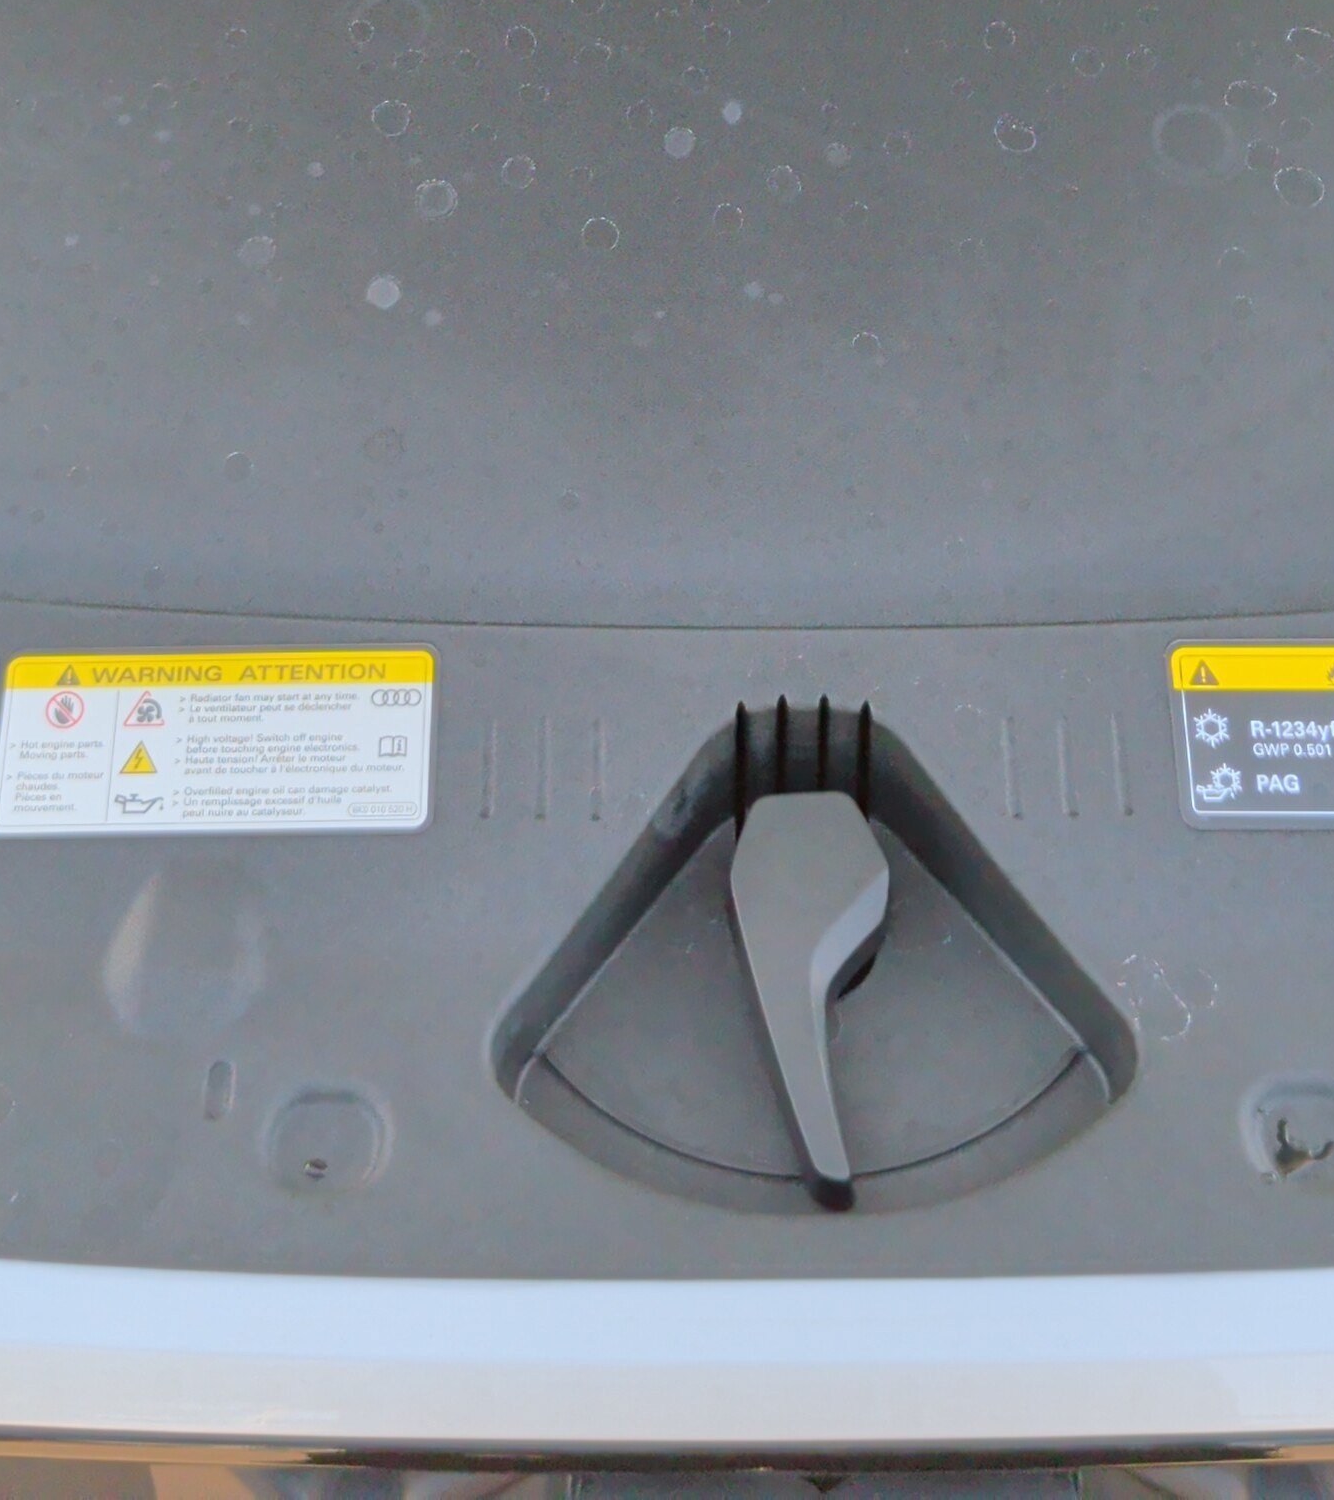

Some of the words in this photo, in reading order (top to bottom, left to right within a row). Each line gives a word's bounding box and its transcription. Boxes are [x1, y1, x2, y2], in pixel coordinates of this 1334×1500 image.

[93, 665, 222, 683] WARNING
[240, 663, 386, 681] ATTENTION
[190, 694, 232, 703] Radiator
[235, 694, 250, 702] fan
[253, 695, 274, 703] may
[278, 693, 299, 701] start
[314, 694, 332, 702] any
[335, 693, 359, 701] time.
[190, 704, 201, 712] Le
[203, 704, 256, 712] ventilateur
[260, 704, 281, 713] peut
[298, 701, 352, 711] déclencher
[189, 714, 194, 722] à
[197, 714, 217, 722] tout
[187, 735, 210, 745] High
[213, 734, 254, 744] voltage!
[257, 734, 290, 742] Switch
[293, 733, 306, 742] off
[309, 734, 343, 743] engine
[20, 741, 38, 749] Hot
[42, 742, 75, 751] engine
[78, 741, 104, 749] parts.
[186, 745, 218, 753] before
[221, 744, 265, 754] touching
[268, 745, 301, 754] engine
[304, 743, 359, 752] electronics.
[1252, 744, 1289, 757] GWP
[1293, 743, 1331, 757] 0.501
[20, 752, 57, 760] Moving
[60, 752, 87, 760] parts.
[186, 755, 214, 764] Haute
[217, 754, 258, 764] tension!
[261, 753, 295, 763] Arrêter
[298, 754, 307, 762] le
[184, 766, 212, 774] avant
[215, 766, 227, 774] de
[230, 765, 268, 774] toucher
[271, 764, 277, 773] à
[280, 764, 348, 774] l'électronique
[351, 764, 364, 772] du
[366, 764, 405, 772] moteur.
[17, 771, 48, 780] Pièces
[15, 783, 58, 791] chaudes.
[1256, 774, 1299, 793] PAG
[184, 786, 233, 795] Overfilled
[236, 787, 269, 797] engine
[272, 786, 284, 795] oil
[288, 787, 305, 795] can
[308, 785, 348, 795] damage
[352, 785, 392, 795] catalyst.
[15, 793, 47, 801] Pièces
[184, 797, 198, 805] Un
[201, 797, 262, 808] remplissage
[265, 796, 306, 805] excessif
[308, 795, 342, 805] d'huile
[13, 803, 76, 812] mouvement.
[182, 808, 204, 818] peut
[208, 808, 233, 817] nuire
[252, 807, 305, 817] catalyseur.
